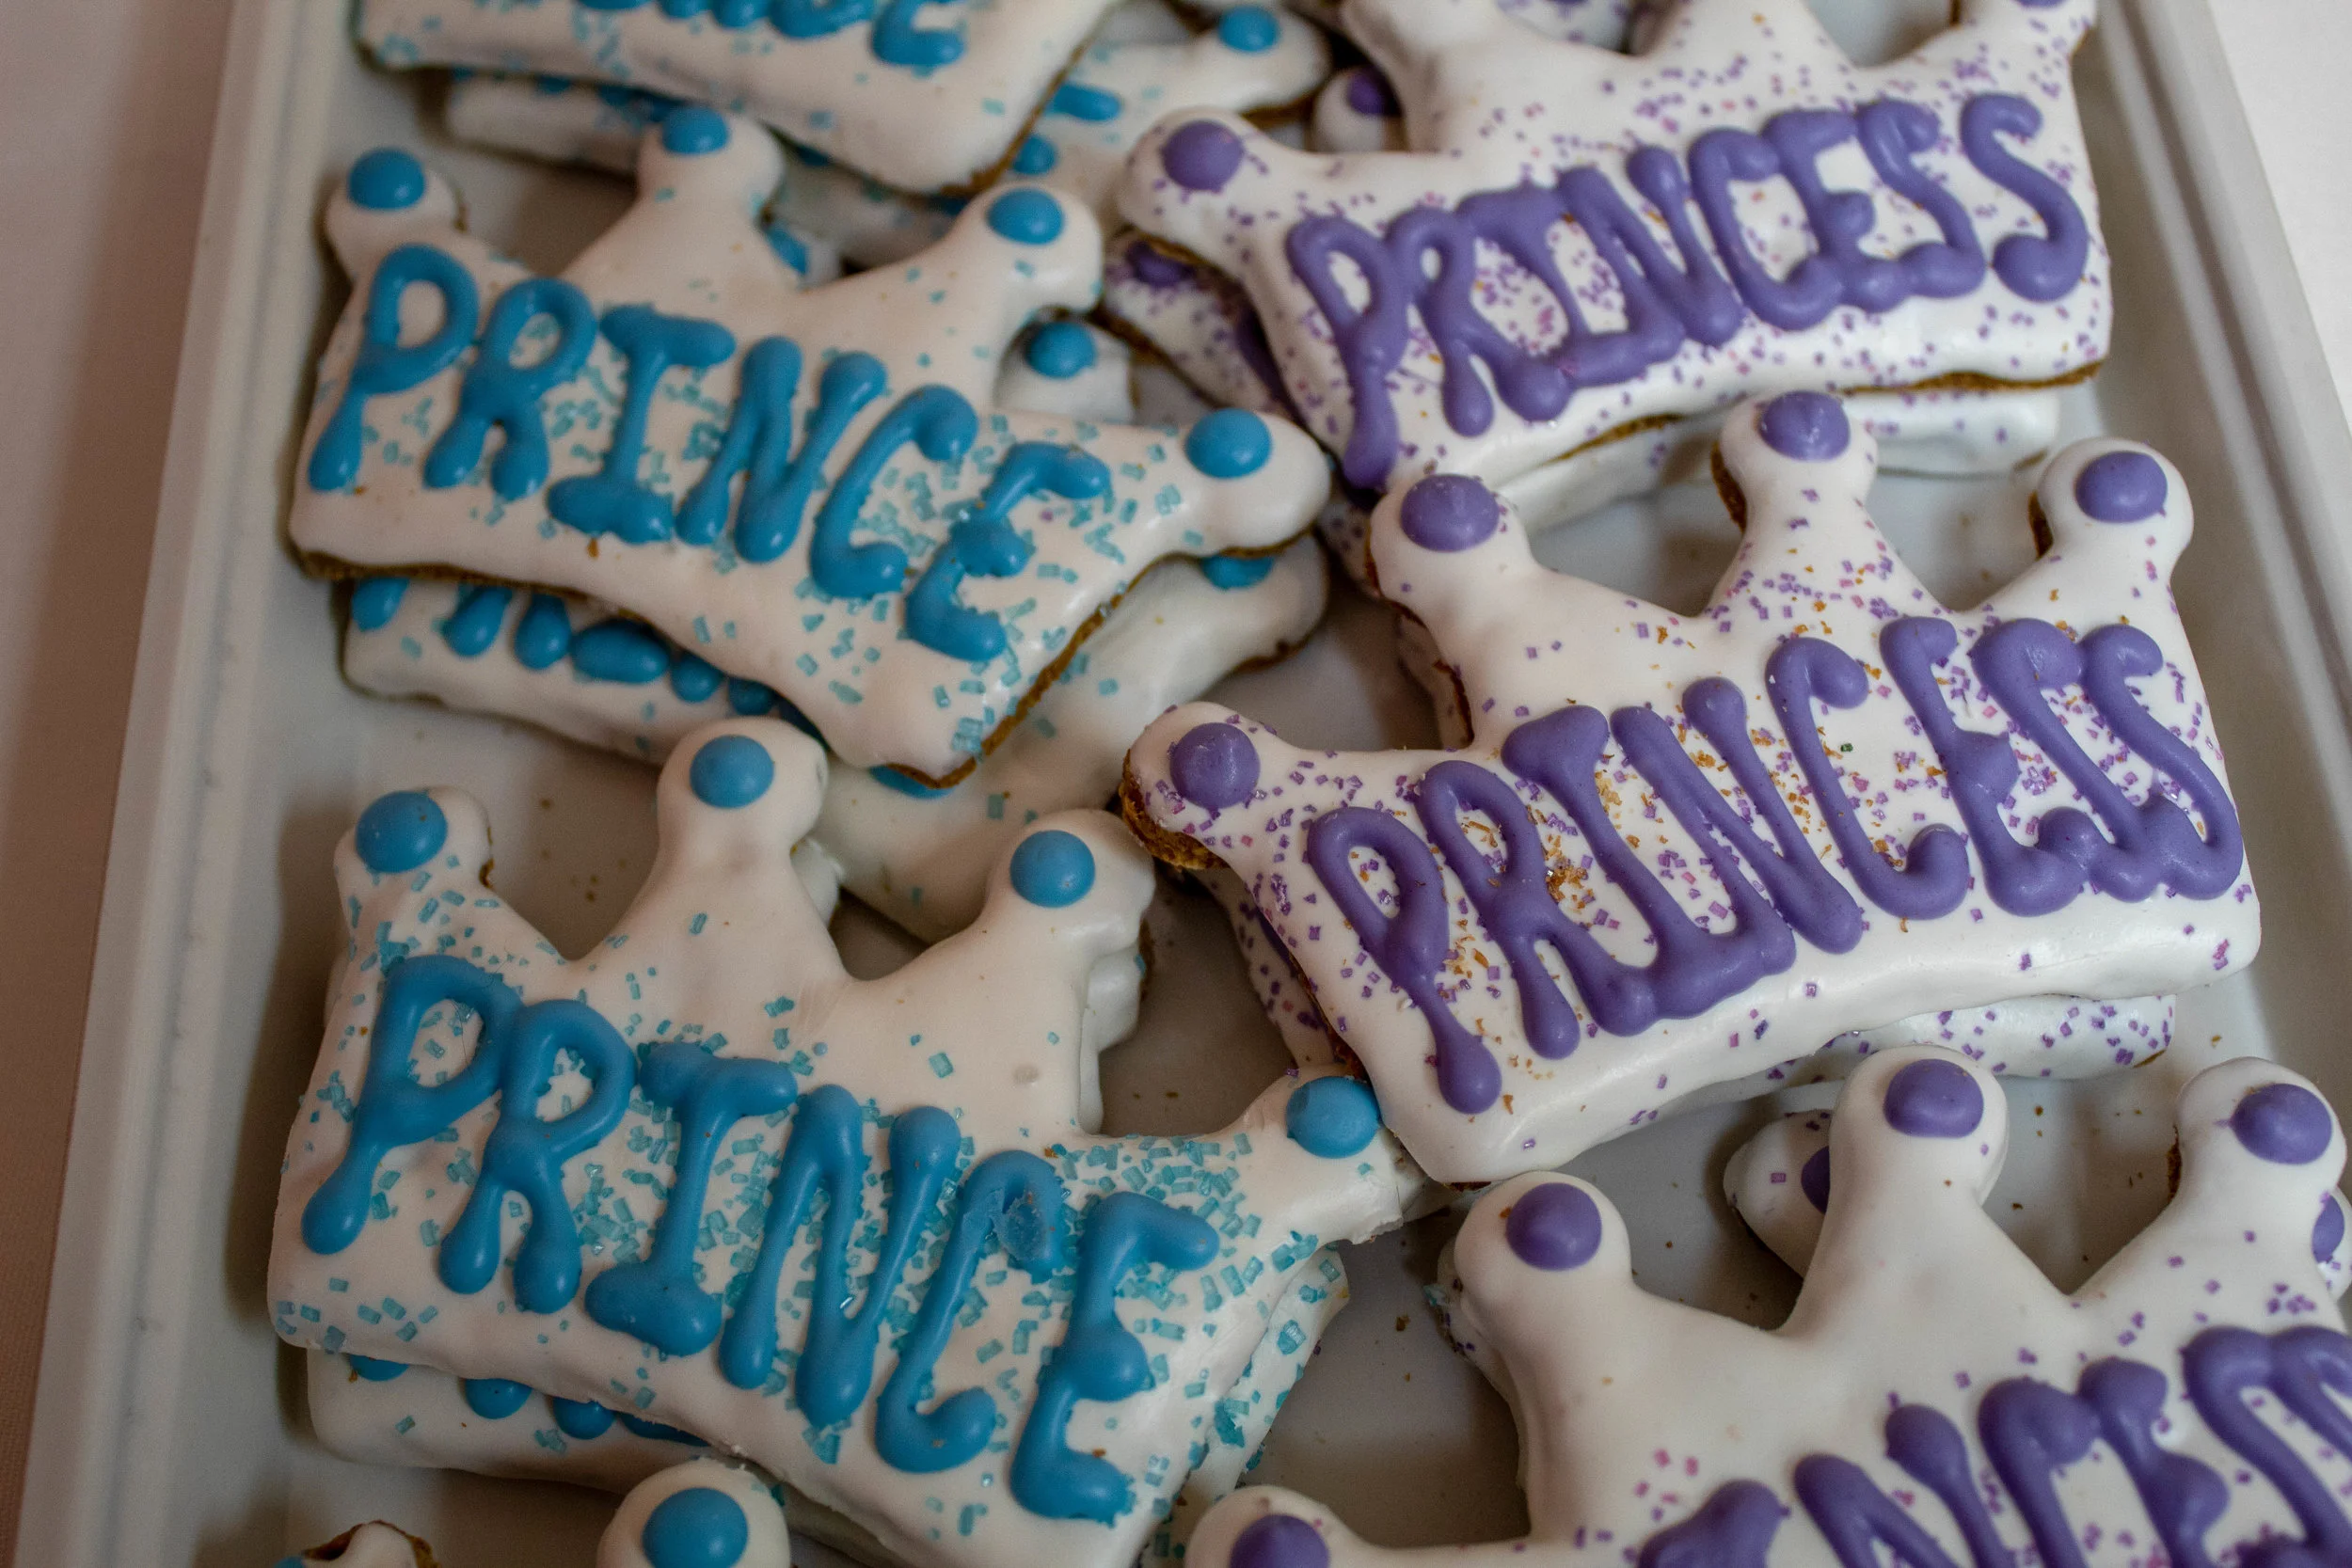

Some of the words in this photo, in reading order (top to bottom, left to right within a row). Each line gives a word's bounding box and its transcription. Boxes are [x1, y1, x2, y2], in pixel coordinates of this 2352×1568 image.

[309, 242, 1111, 661] PRINCE
[1286, 92, 2088, 490] PRINCESS
[1307, 616, 2244, 1115] PRINCESS
[300, 955, 1220, 1525] PRINCE
